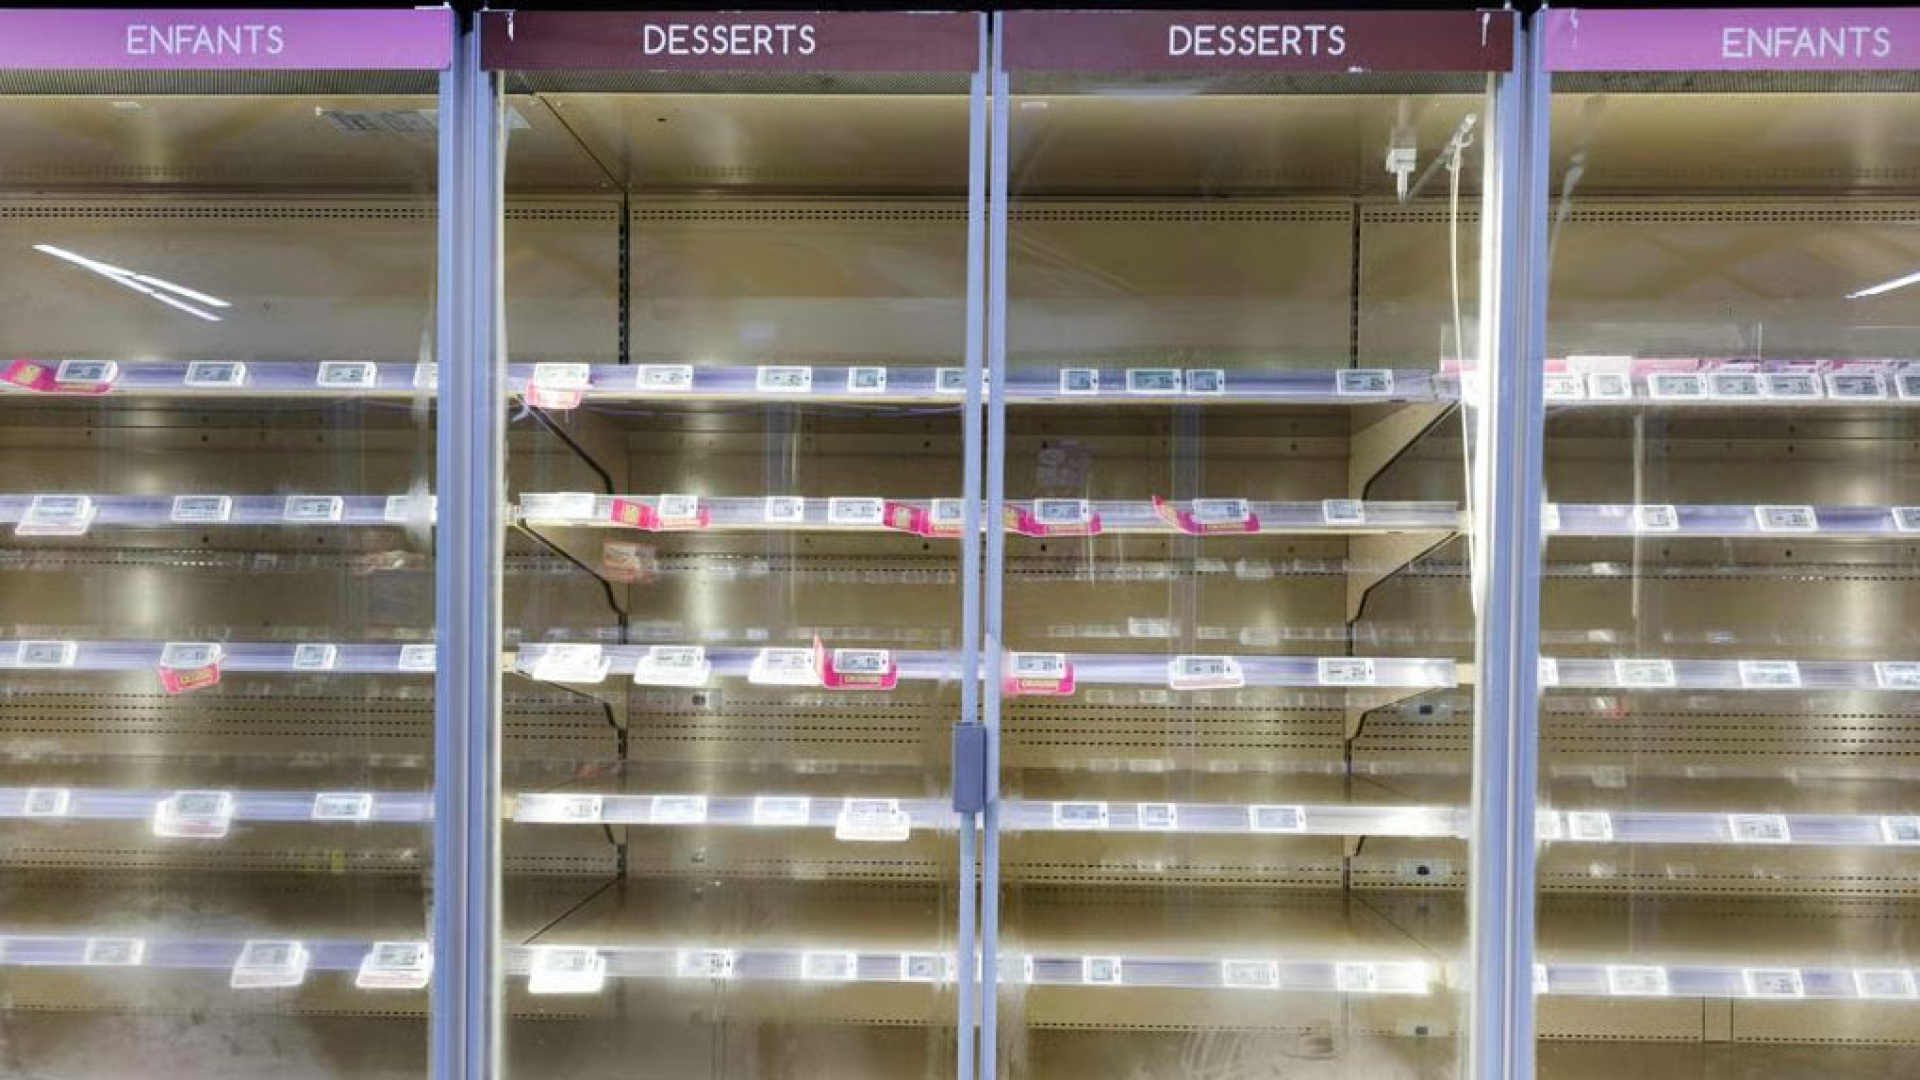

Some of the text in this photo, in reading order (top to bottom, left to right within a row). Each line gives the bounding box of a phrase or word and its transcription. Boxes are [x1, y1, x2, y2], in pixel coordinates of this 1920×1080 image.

[127, 25, 284, 55] ENFANTS
[644, 24, 816, 56] DESSERTS
[1168, 25, 1346, 57] DESSERTS
[1721, 27, 1891, 59] ENFANTS
